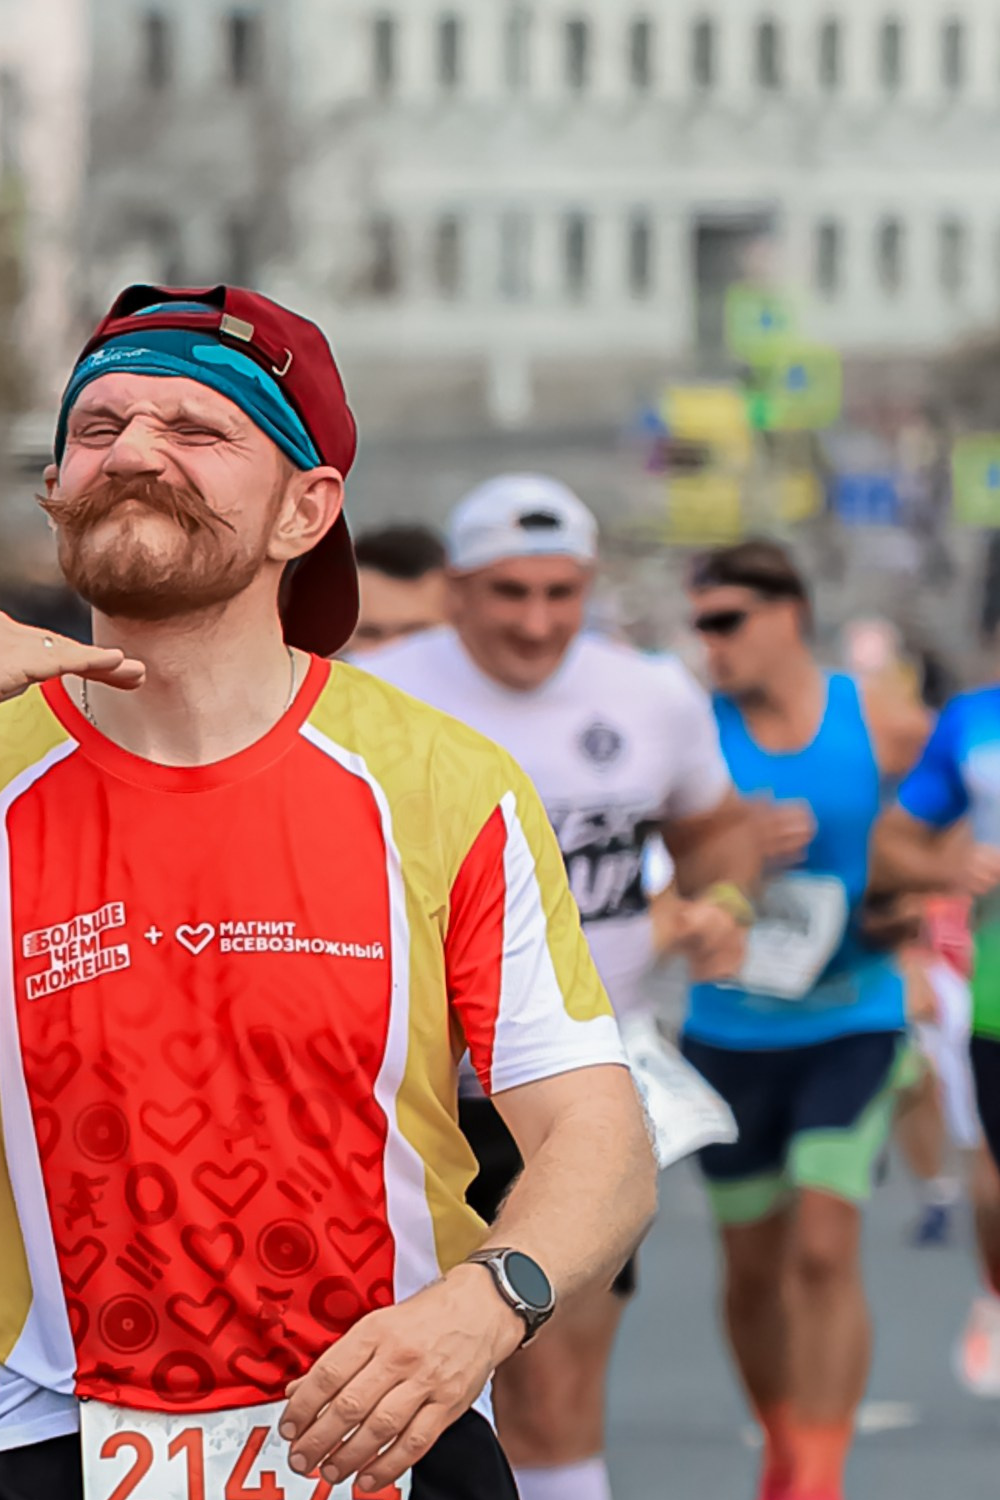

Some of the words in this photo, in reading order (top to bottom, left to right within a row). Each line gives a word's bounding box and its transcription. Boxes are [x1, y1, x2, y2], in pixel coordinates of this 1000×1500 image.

[31, 904, 122, 953] БОЛЬШЕ
[219, 921, 296, 936] МАГНИТ
[53, 935, 98, 965] ЧЕМ
[220, 936, 385, 960] ВСЕВОЗМОЖНЫЙ
[29, 948, 127, 997] МОЖЕШЬ
